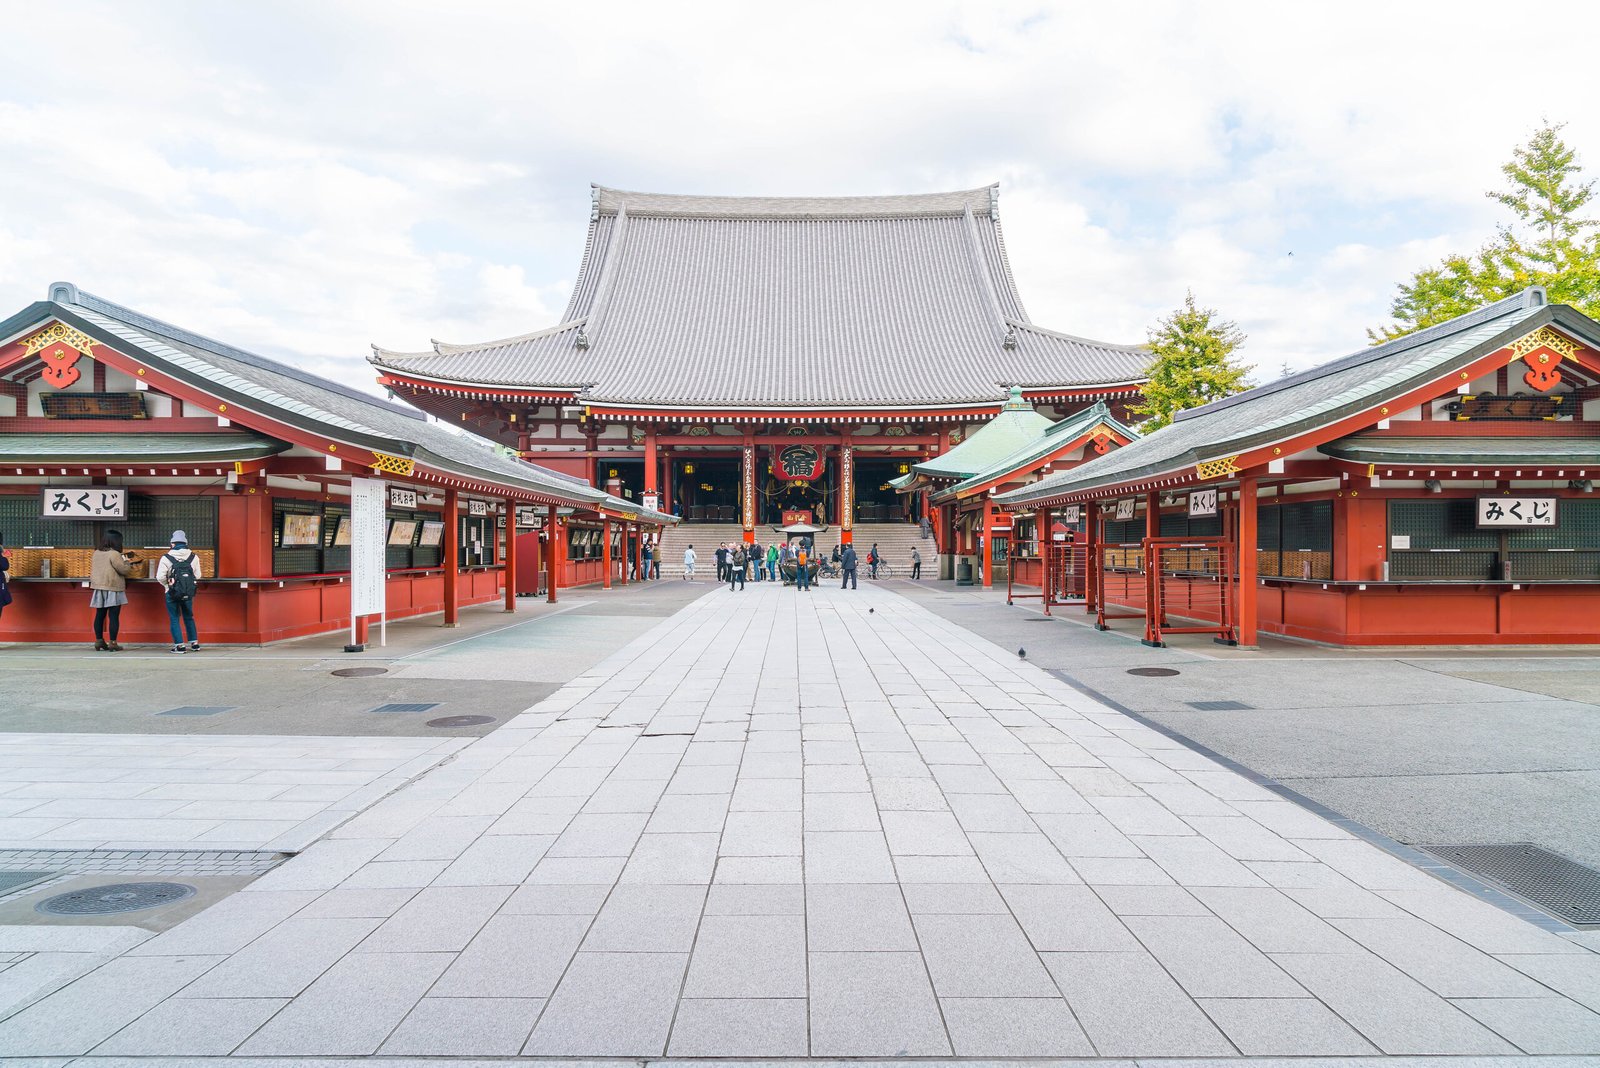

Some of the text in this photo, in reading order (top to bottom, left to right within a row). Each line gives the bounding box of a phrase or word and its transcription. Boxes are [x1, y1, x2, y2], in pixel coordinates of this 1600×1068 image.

[52, 492, 118, 512] みくじ
[1192, 494, 1215, 511] みくじ
[1486, 501, 1549, 520] みくじ
